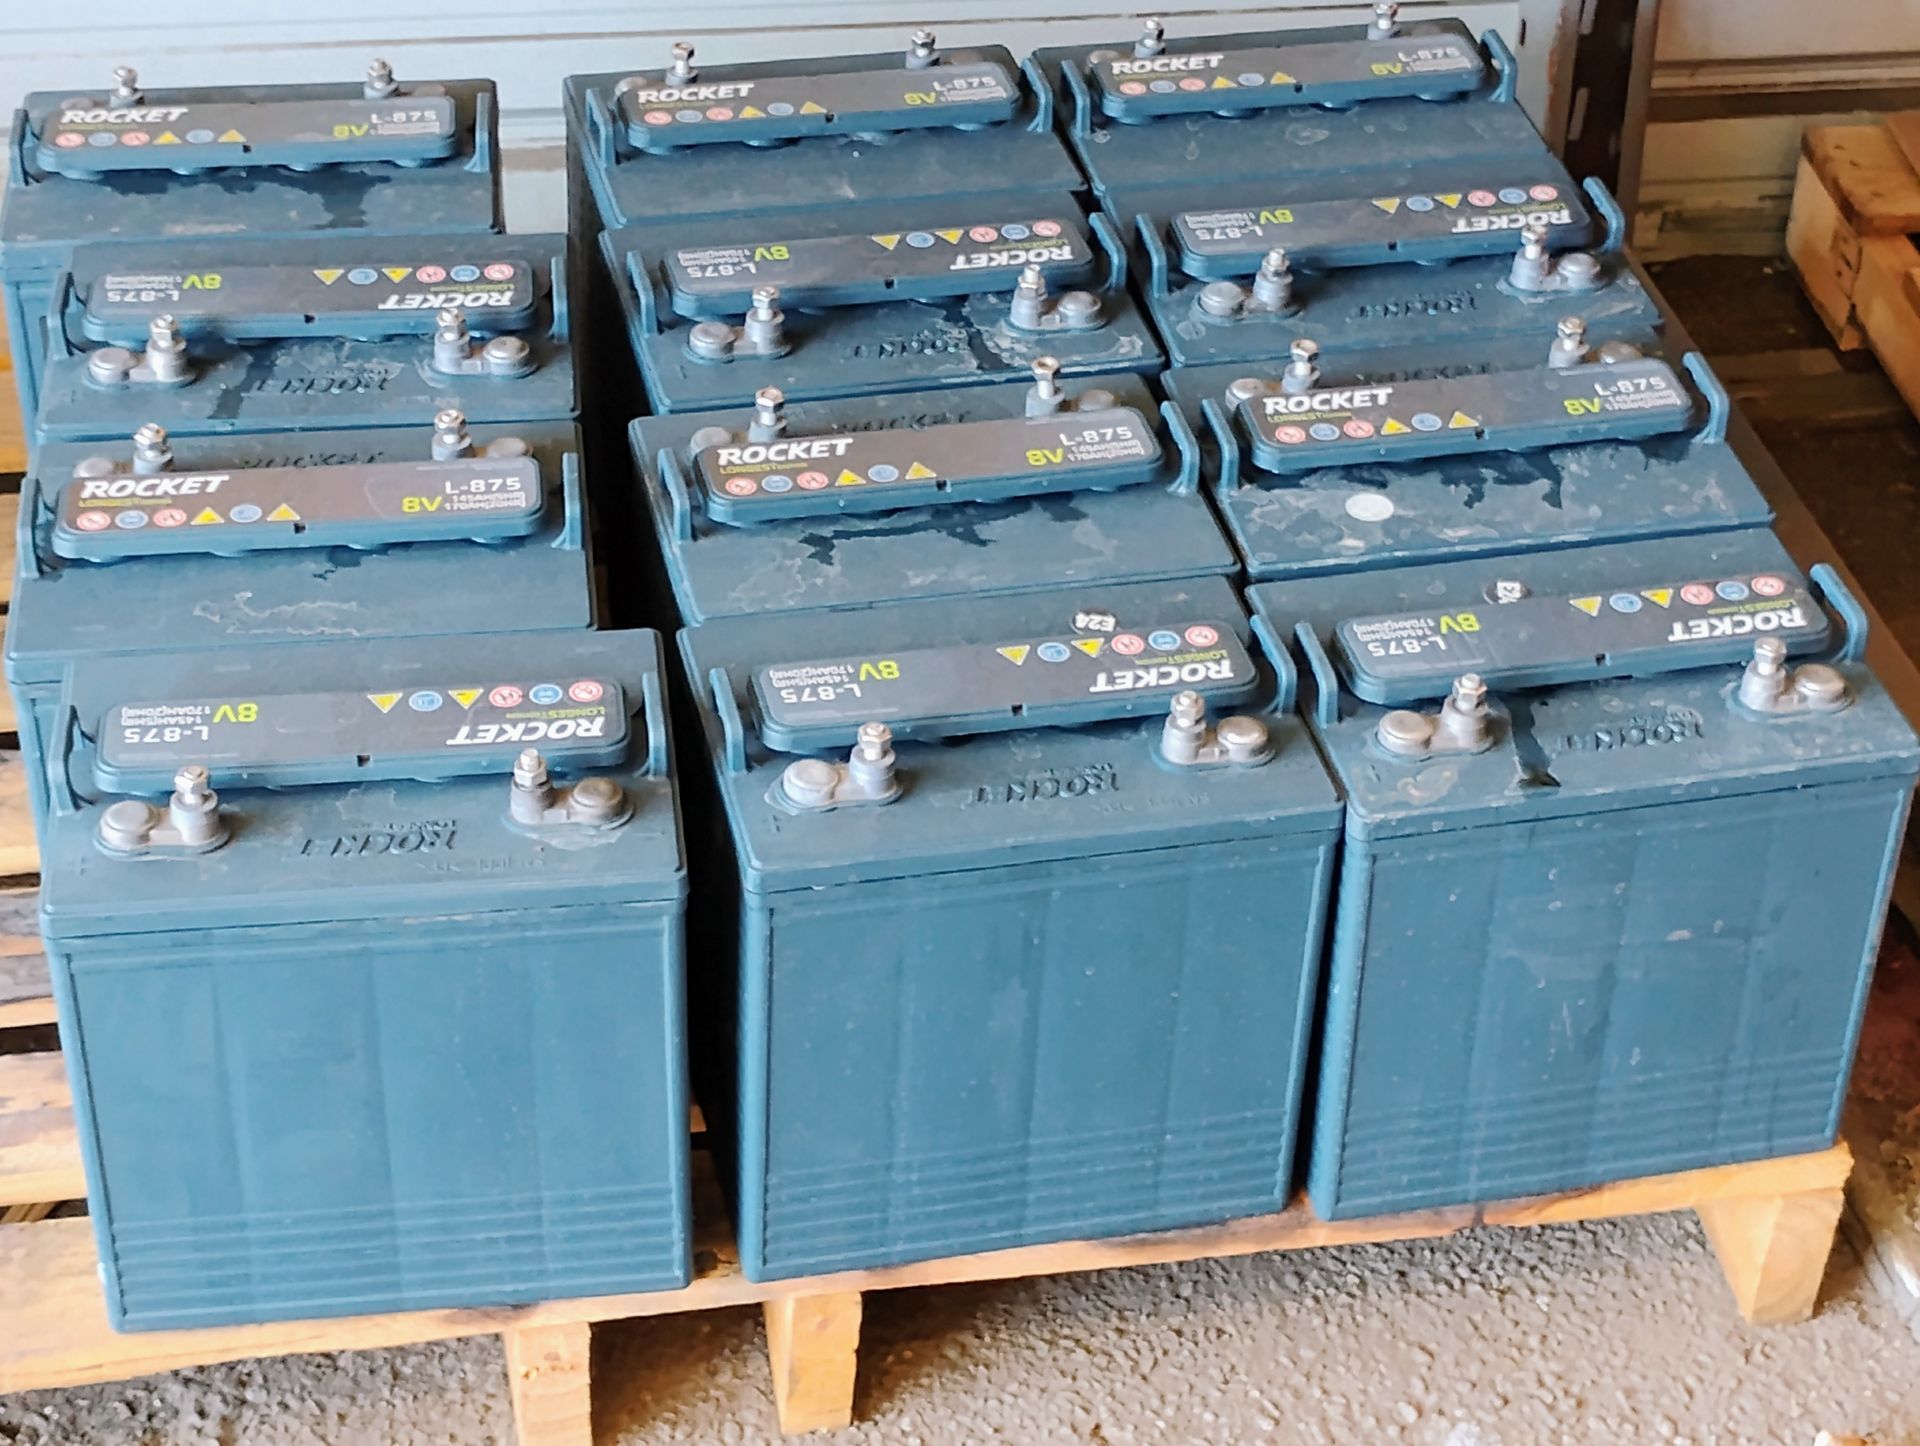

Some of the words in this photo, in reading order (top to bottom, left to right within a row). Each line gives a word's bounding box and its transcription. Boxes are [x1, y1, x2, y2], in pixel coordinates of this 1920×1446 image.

[1111, 55, 1224, 75] ROCKET
[637, 84, 754, 103] ROCKET
[61, 108, 188, 124] ROCKET
[1451, 209, 1573, 232] ROCKET
[1196, 224, 1263, 240] L-875
[754, 245, 790, 262] 8V
[950, 245, 1073, 270] ROCKET
[687, 262, 756, 278] L-875
[182, 273, 222, 289] 8V
[107, 290, 179, 302] L-875
[378, 290, 513, 309] ROCKET
[1263, 387, 1393, 414] ROCKET
[1563, 397, 1601, 416] 8V
[1594, 377, 1667, 397] L-875
[717, 438, 853, 465] ROCKET
[1026, 448, 1064, 465] 8V
[1059, 427, 1133, 447] L-875
[81, 475, 230, 498] ROCKET
[402, 496, 442, 512] 8V
[445, 477, 521, 494] L-875
[1075, 612, 1116, 632] E24
[1439, 613, 1479, 634] 8V
[1667, 608, 1807, 642] ROCKET
[1367, 636, 1446, 657] L-875
[858, 660, 900, 682] 8V
[1089, 659, 1233, 693] ROCKET
[780, 682, 862, 704] L-875
[214, 703, 259, 723] 8V
[124, 725, 209, 743] L-875
[446, 718, 604, 746] ROCKET
